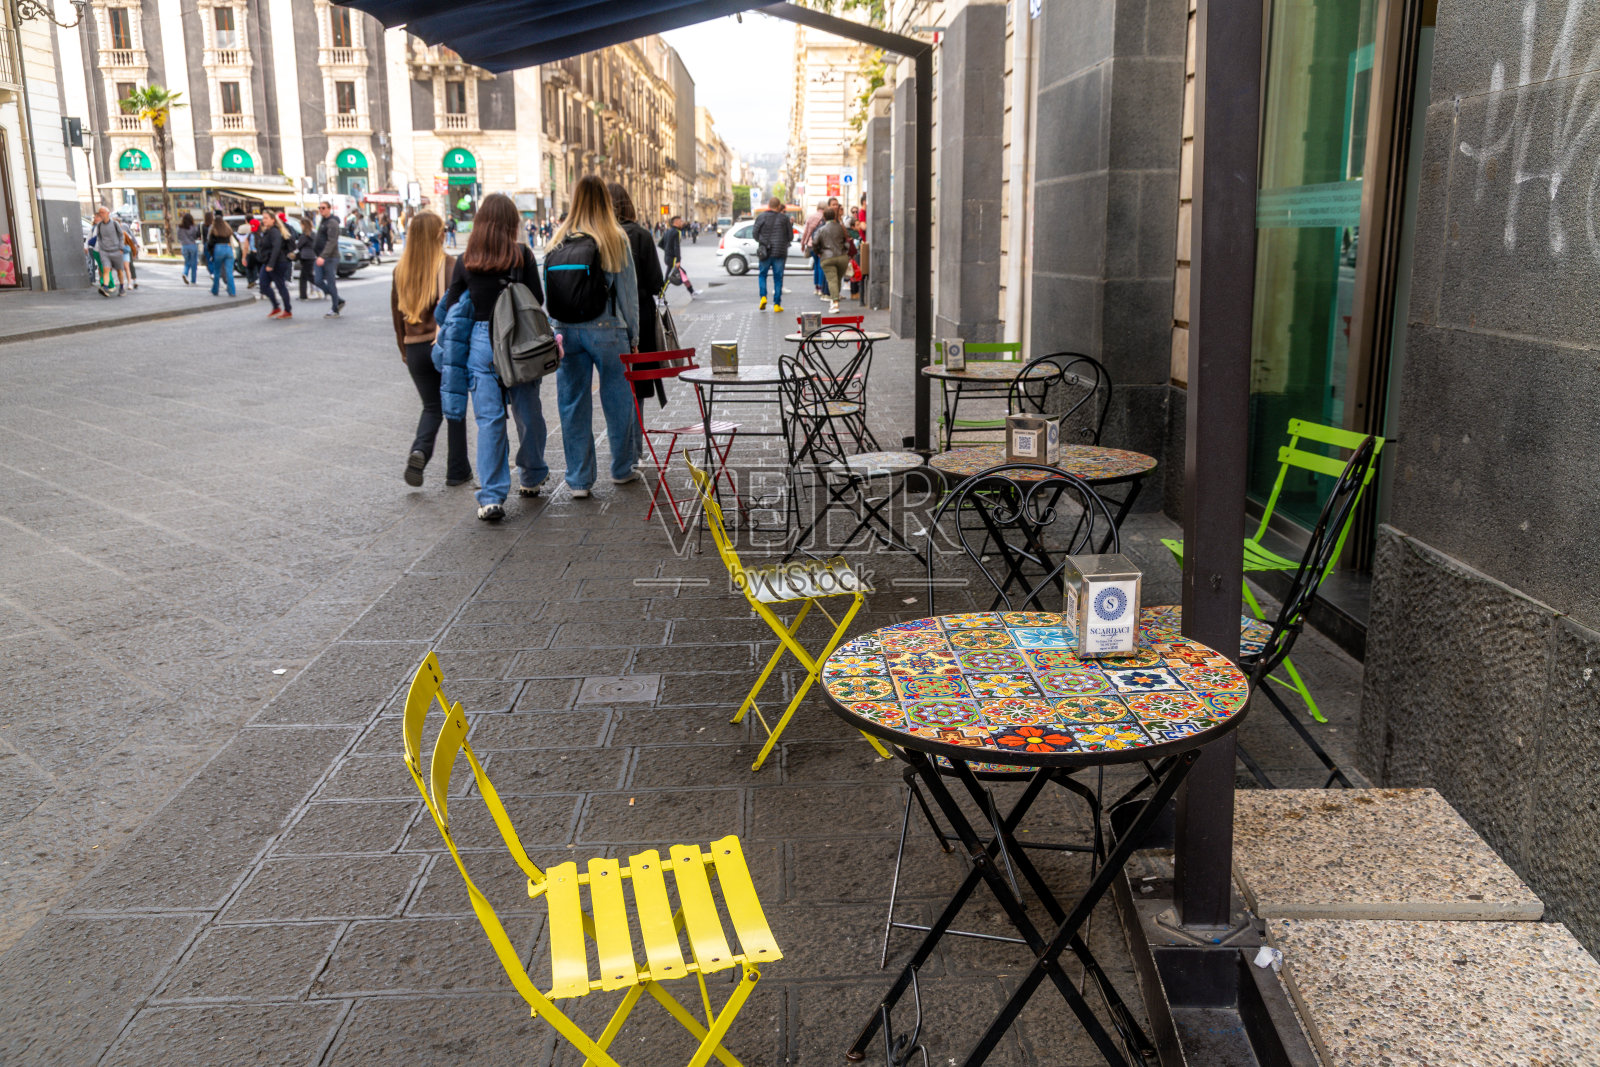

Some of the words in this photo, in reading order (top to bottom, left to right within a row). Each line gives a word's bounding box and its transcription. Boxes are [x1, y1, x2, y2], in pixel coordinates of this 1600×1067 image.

[232, 153, 243, 165] D
[346, 154, 357, 165] D
[454, 153, 465, 165] D
[1106, 598, 1114, 609] S
[1090, 626, 1130, 635] SCARDACI
